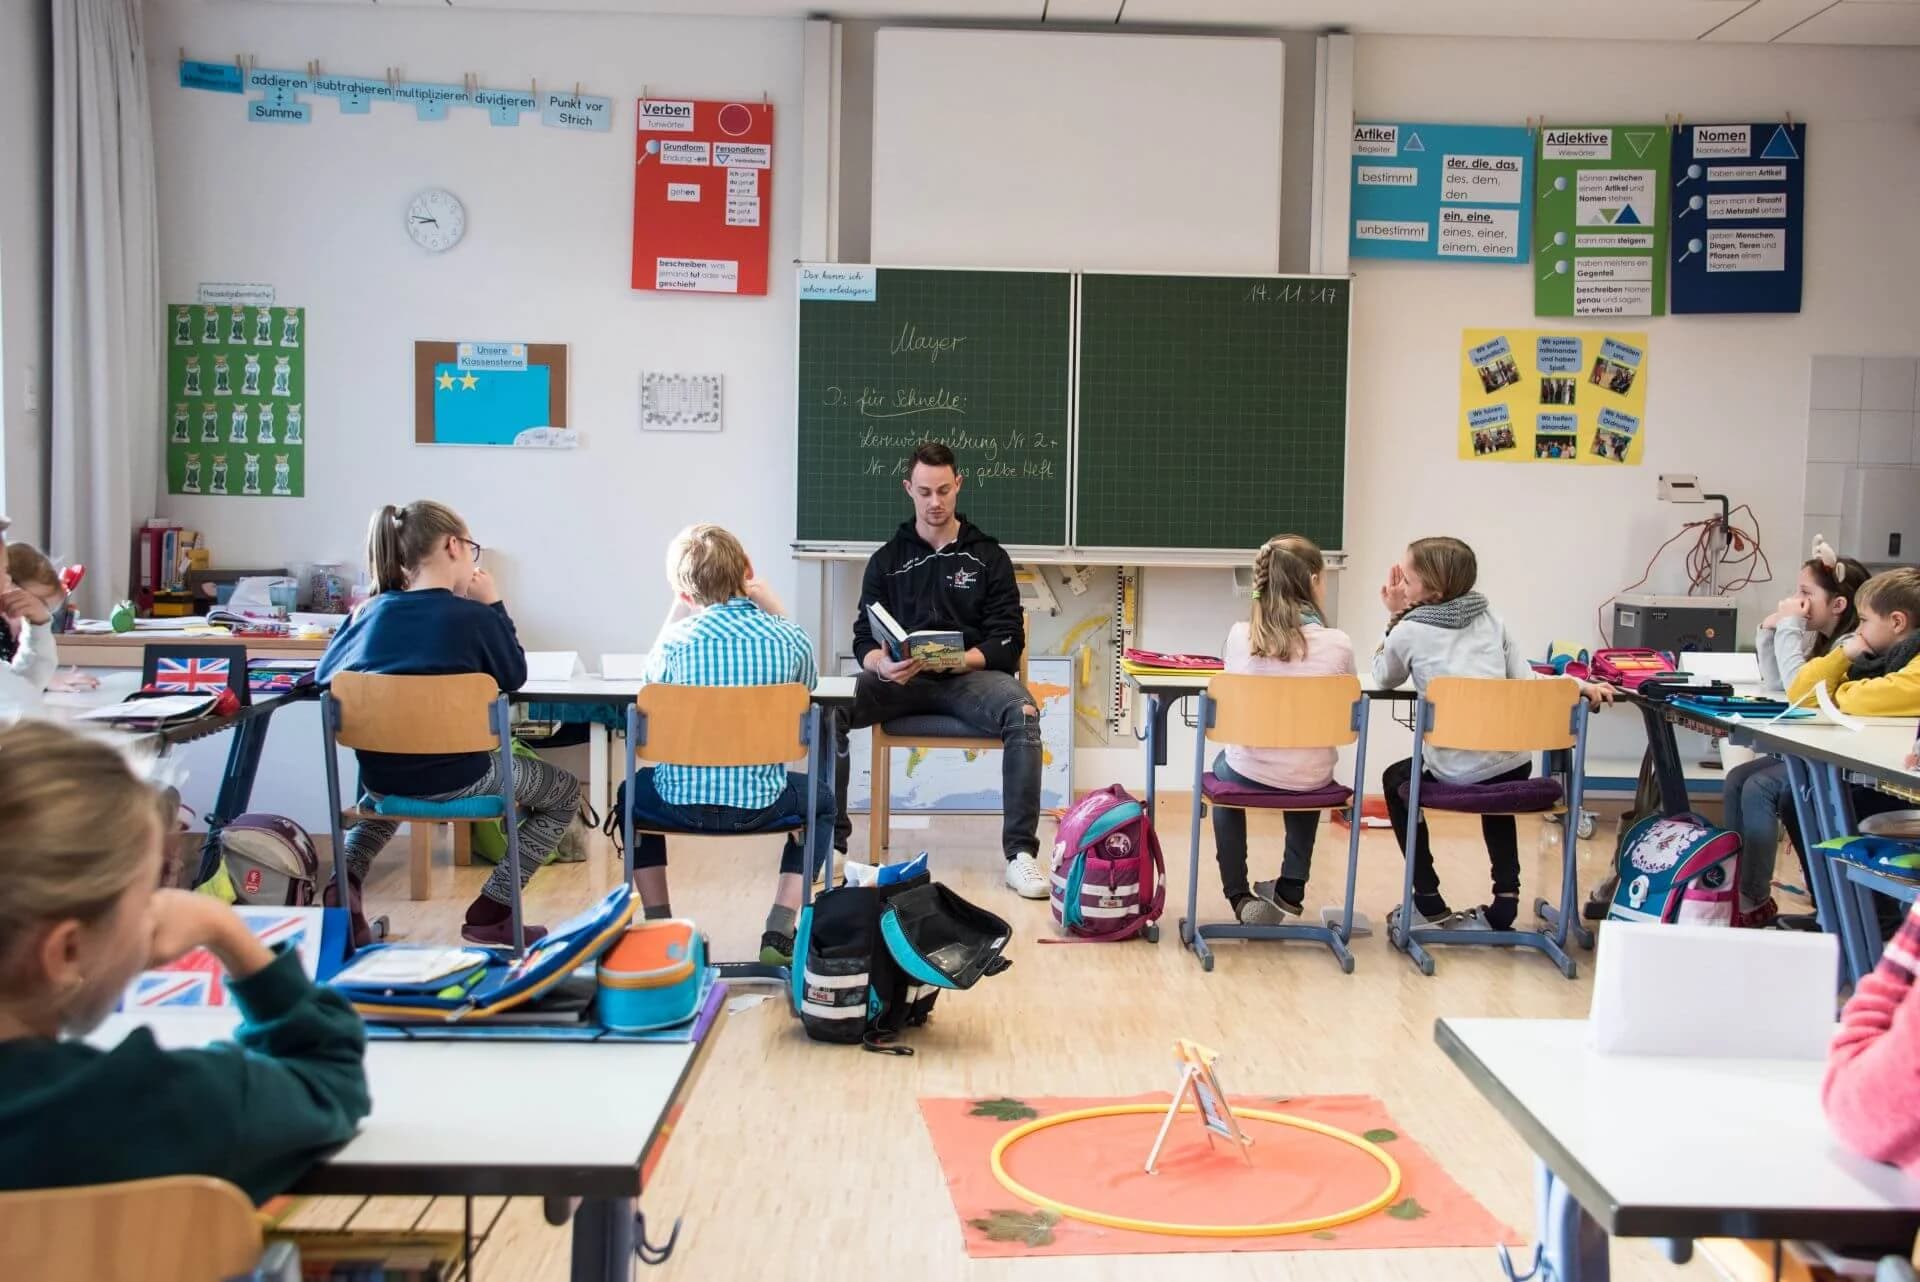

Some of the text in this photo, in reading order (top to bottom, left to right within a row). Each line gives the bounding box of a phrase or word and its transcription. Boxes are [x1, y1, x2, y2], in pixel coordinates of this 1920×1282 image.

[251, 73, 308, 89] addieren
[316, 80, 392, 96] subtrahieren
[395, 87, 469, 102] multiplizieren
[475, 93, 536, 108] dividieren
[550, 96, 604, 112] Punkt vor
[643, 103, 691, 117] Verben
[255, 105, 302, 119] Summe
[559, 113, 593, 127] Strich
[1355, 128, 1396, 141] Artikel
[1546, 132, 1609, 145] Adjektive
[1699, 130, 1747, 142] Nomen
[1358, 145, 1391, 154] Begleiter
[1447, 157, 1519, 171] der, die, das,
[1362, 169, 1414, 184] bestimmt
[1609, 174, 1643, 182] zwischen
[1758, 168, 1782, 177] Artikel
[1446, 173, 1501, 187] des, dem,
[671, 189, 695, 197] gehen
[1604, 184, 1628, 192] Artikel
[1445, 189, 1468, 200] den
[1579, 194, 1607, 202] Nomen
[1443, 210, 1493, 224] ein, eine,
[1725, 207, 1760, 215] Mehrzahl
[1360, 223, 1425, 238] unbestimmt
[1477, 228, 1508, 240] einer,
[1617, 236, 1646, 246] steigern
[1739, 241, 1761, 249] Tieren
[1482, 243, 1514, 254] einen
[1709, 252, 1740, 261] Pflanzen
[1577, 269, 1615, 279] Gegenteil
[658, 279, 697, 288] geschieht
[1576, 285, 1623, 294] beschreiben
[1576, 296, 1601, 305] genau
[1576, 306, 1623, 314] wie etwas ist
[891, 320, 968, 364] Mayer
[476, 345, 508, 355] Unsere
[461, 357, 523, 368] Klassensterne
[858, 386, 884, 415] für
[892, 386, 968, 409] Schnelle:
[1001, 430, 1026, 450] Nr
[863, 456, 887, 475] Nr
[976, 463, 1017, 487] gelbe
[1023, 457, 1055, 481] Heft
